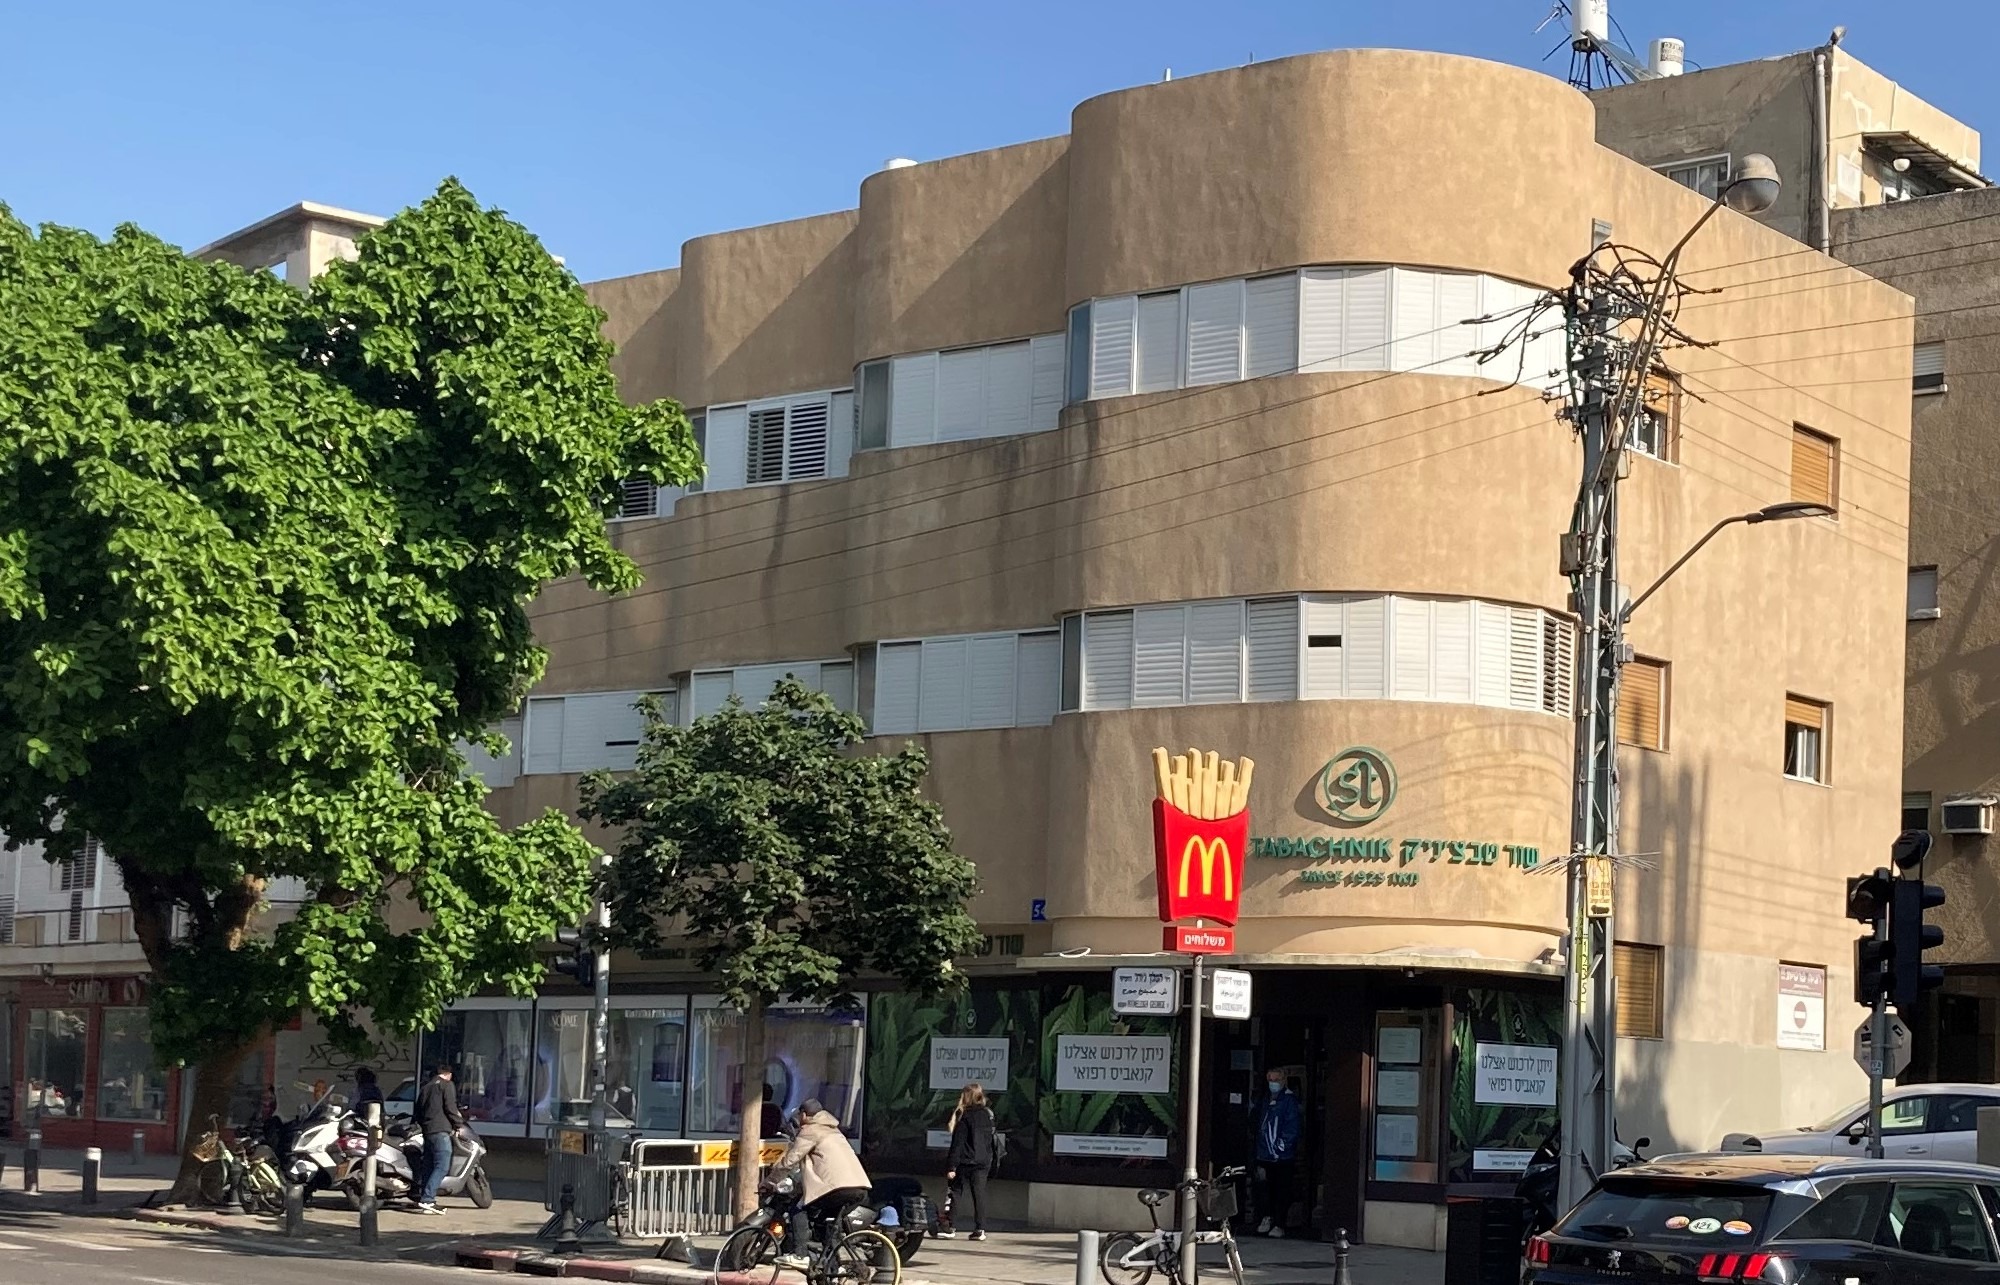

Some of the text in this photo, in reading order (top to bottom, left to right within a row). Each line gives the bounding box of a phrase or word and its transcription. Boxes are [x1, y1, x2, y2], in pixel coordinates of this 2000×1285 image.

[1251, 836, 1393, 858] TABACHNIK
[1506, 844, 1540, 868] שור
[1301, 870, 1386, 884] SINCE 1925
[1184, 934, 1226, 947] משלוחים
[935, 1045, 1005, 1064] ניתן לרכוש אצלנו
[1064, 1043, 1164, 1064] ניתן לרכוש אצלנו
[941, 1066, 997, 1082] קנאביס רפואי
[1481, 1053, 1553, 1076] ניתן לרכוש אצלנו
[1072, 1066, 1154, 1084] קנאביס רפואי
[1487, 1077, 1546, 1096] קנאביס רפואי
